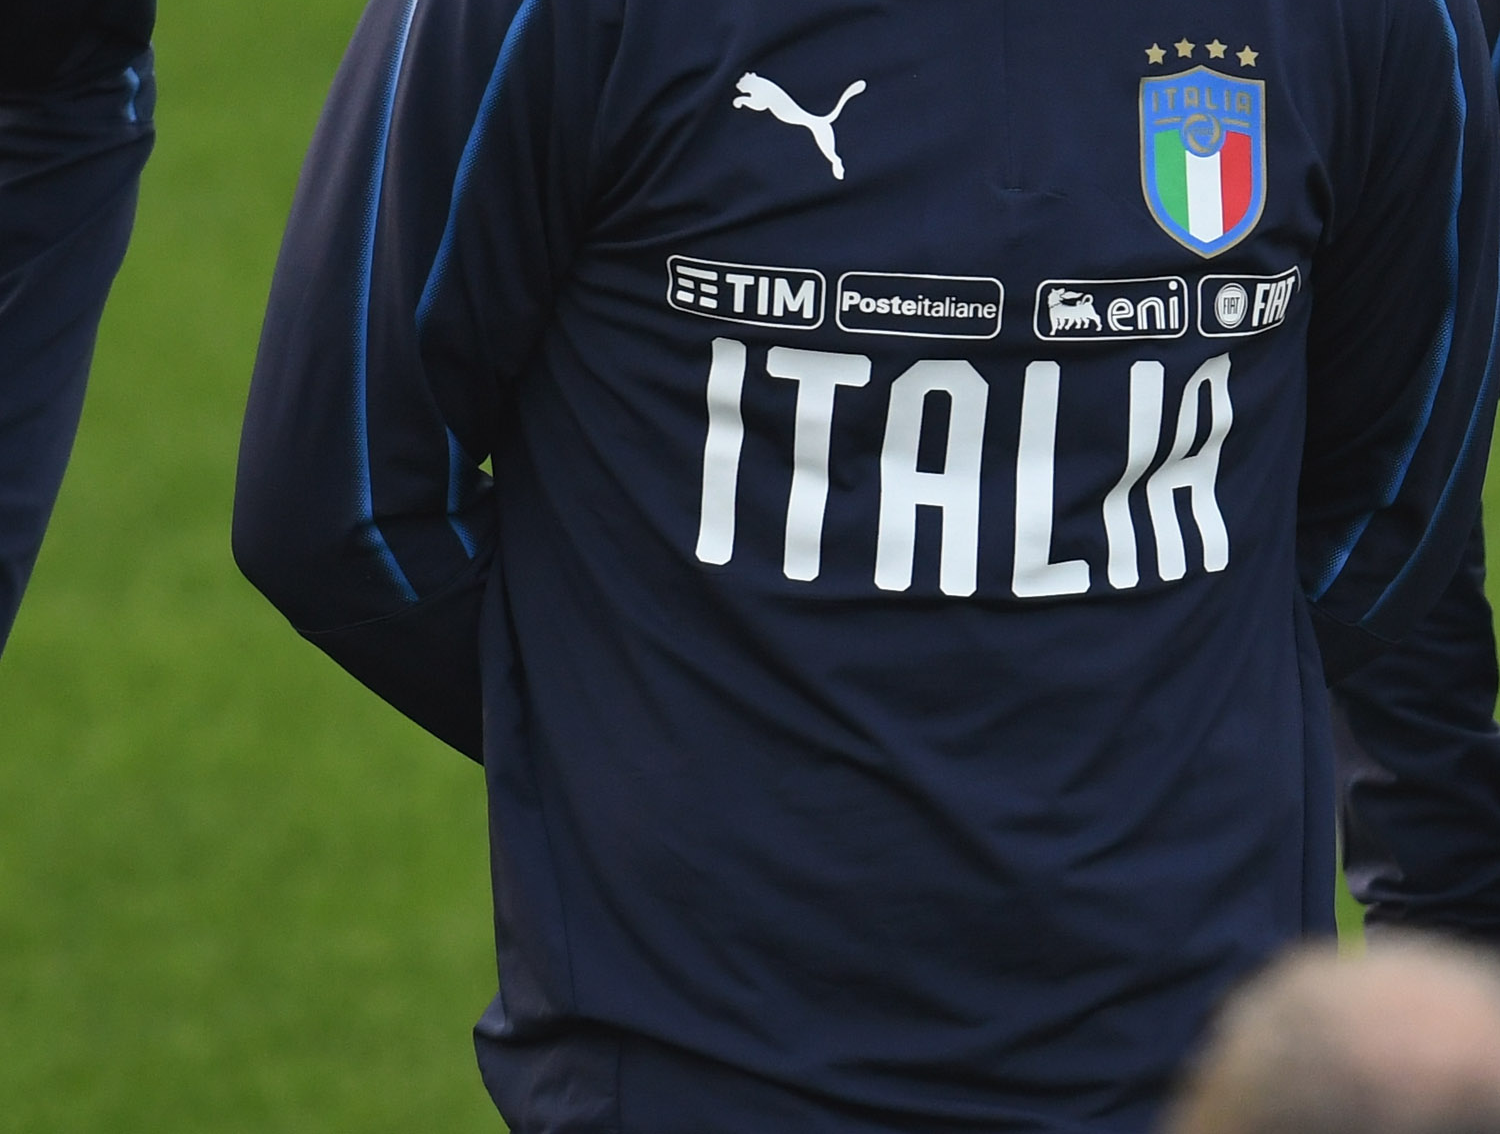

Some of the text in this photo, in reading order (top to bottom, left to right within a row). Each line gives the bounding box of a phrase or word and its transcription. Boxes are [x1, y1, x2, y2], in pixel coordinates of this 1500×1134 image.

[1152, 86, 1251, 114] ITALIA
[725, 273, 815, 318] TIM
[842, 291, 997, 319] Posteitaliane
[1107, 280, 1178, 331] eni
[1223, 297, 1240, 314] FIAT
[1252, 276, 1296, 327] FIAT
[695, 337, 1233, 597] ITALIA
